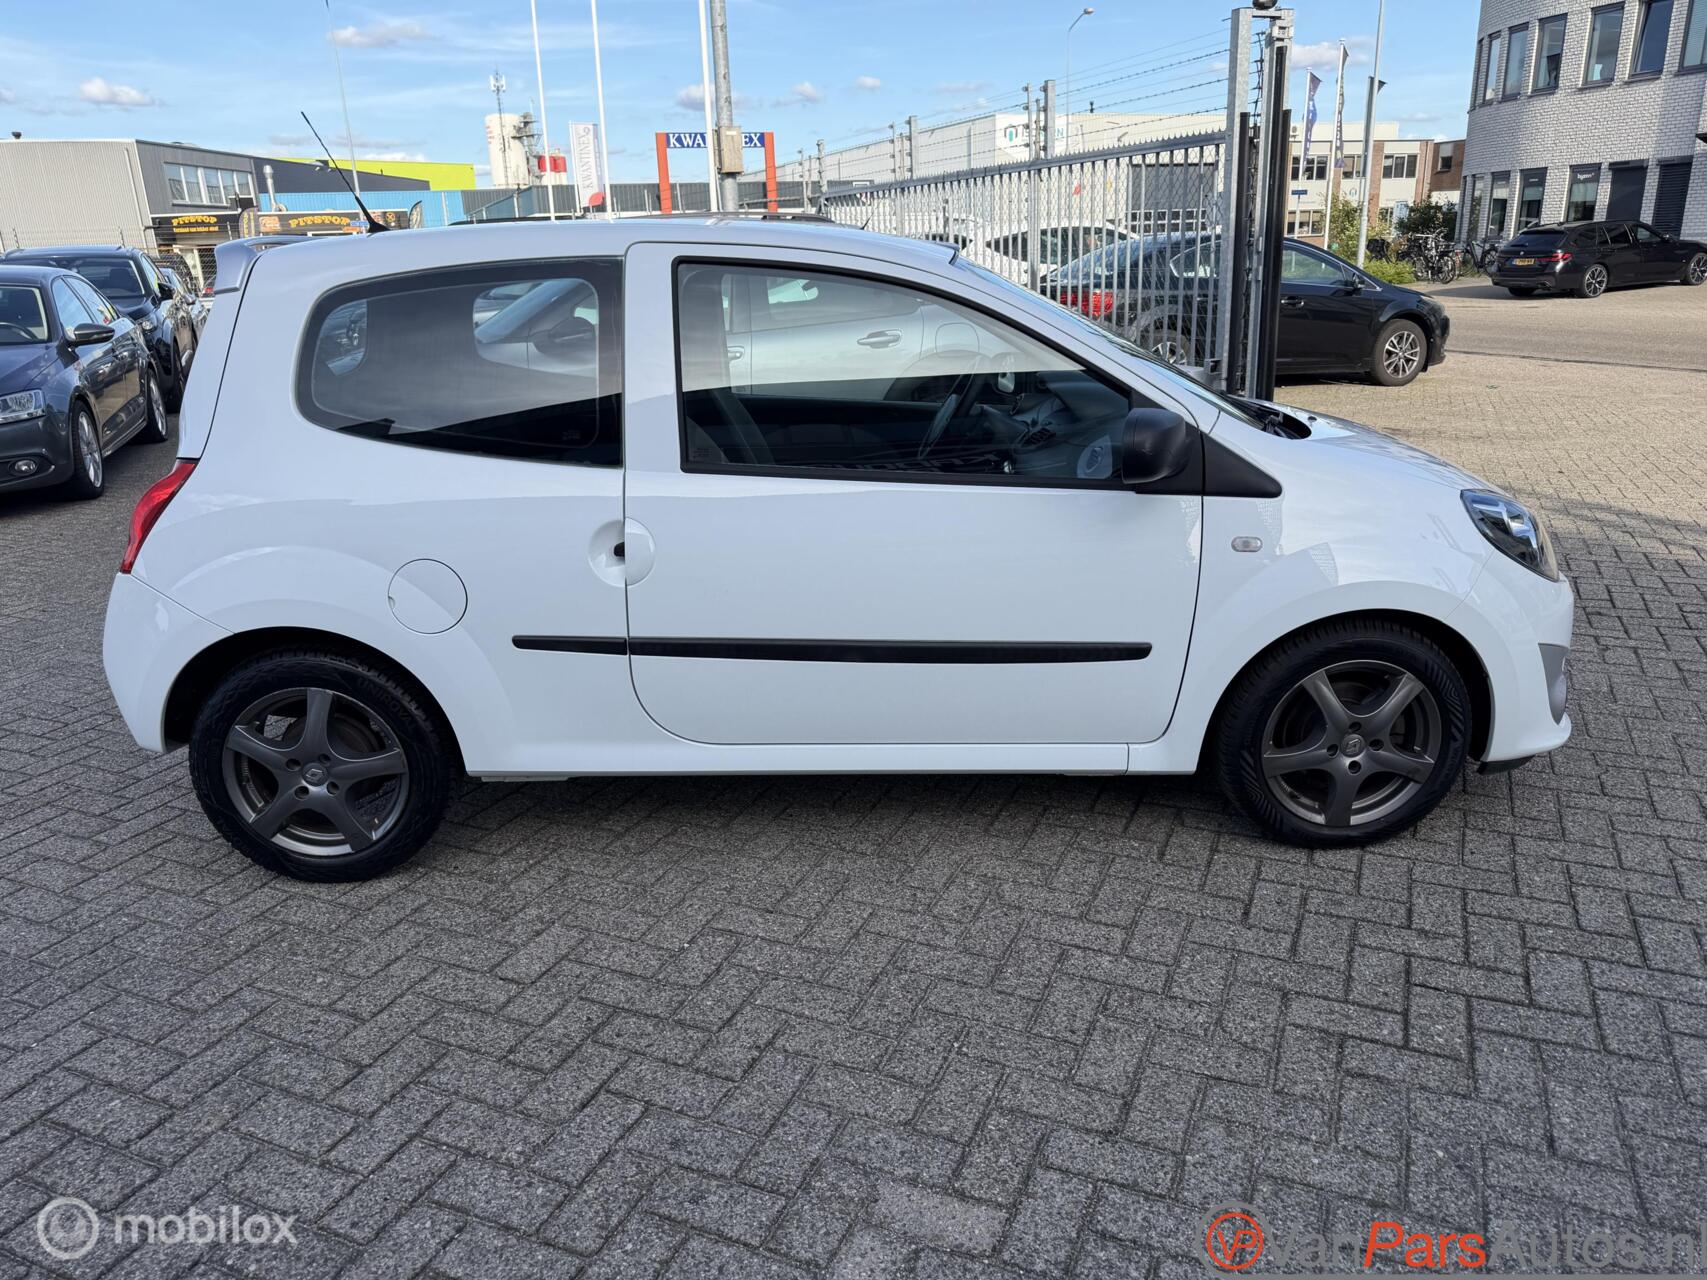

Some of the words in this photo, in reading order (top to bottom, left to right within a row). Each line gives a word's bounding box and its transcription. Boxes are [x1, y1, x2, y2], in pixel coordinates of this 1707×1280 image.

[669, 133, 761, 148] KWAEX
[171, 215, 218, 226] PITSTOP
[288, 216, 350, 229] PITSTOP
